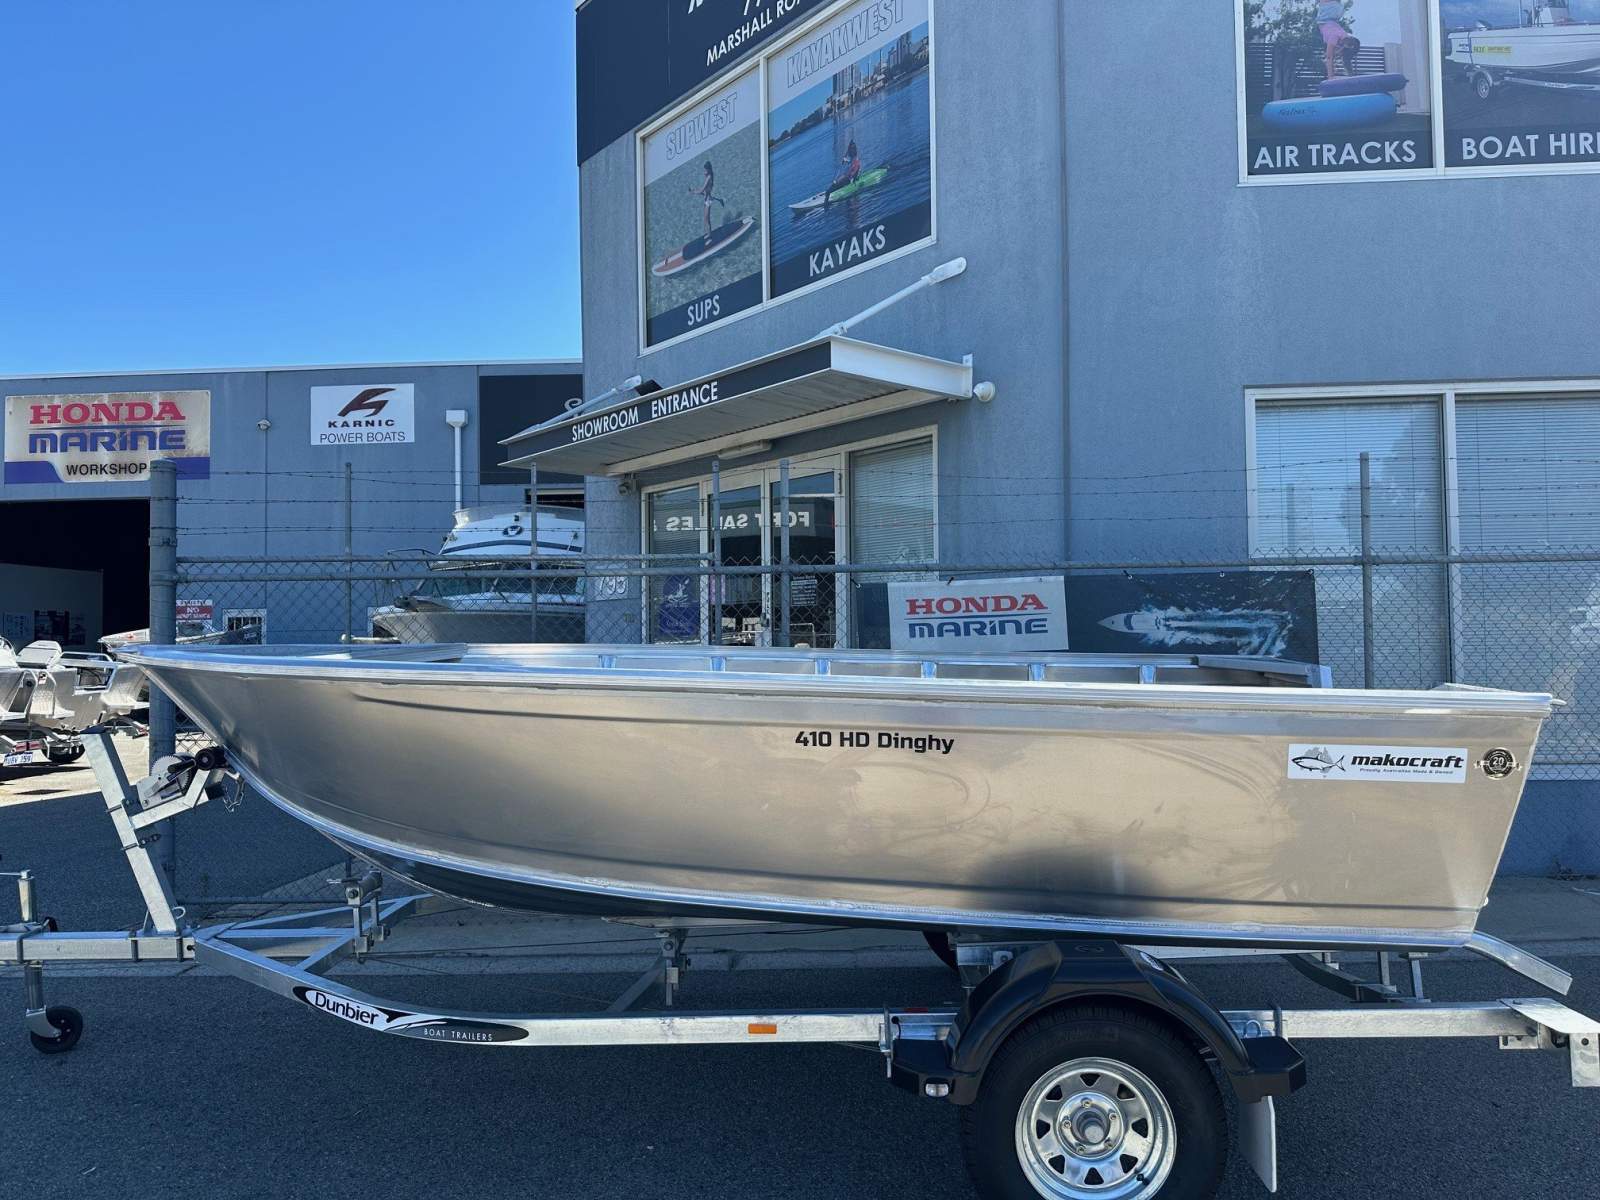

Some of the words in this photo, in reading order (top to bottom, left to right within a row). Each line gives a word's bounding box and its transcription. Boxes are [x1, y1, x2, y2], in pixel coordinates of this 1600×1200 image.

[706, 8, 772, 66] MARSHALL
[777, 0, 801, 18] RO
[786, 0, 903, 88] KAYAKWEST
[665, 92, 738, 160] SUPWEST
[1254, 145, 1300, 168] AIR
[1307, 140, 1416, 166] TRACKS
[1462, 133, 1539, 160] BOAT
[1549, 132, 1600, 156] HIR
[810, 225, 886, 277] KAYAKS
[687, 295, 721, 326] SUPS
[30, 401, 186, 424] HONDA
[572, 406, 639, 441] SHOWROOM
[651, 382, 718, 418] ENTRANCE
[328, 419, 395, 428] KARNIC
[29, 429, 186, 453] MARINE
[320, 432, 363, 443] POWER
[367, 431, 406, 442] BOATS
[66, 463, 148, 475] WORKSHOP
[905, 594, 1048, 615] HONDA
[908, 618, 1048, 638] MARINE
[795, 731, 832, 747] 410
[840, 731, 870, 747] HD
[878, 732, 954, 754] Dinghy
[1350, 754, 1464, 768] makocraft
[1492, 757, 1505, 765] 20
[315, 992, 379, 1025] Dunbier
[424, 1028, 445, 1037] BOAT
[451, 1031, 492, 1041] TRAILERS
